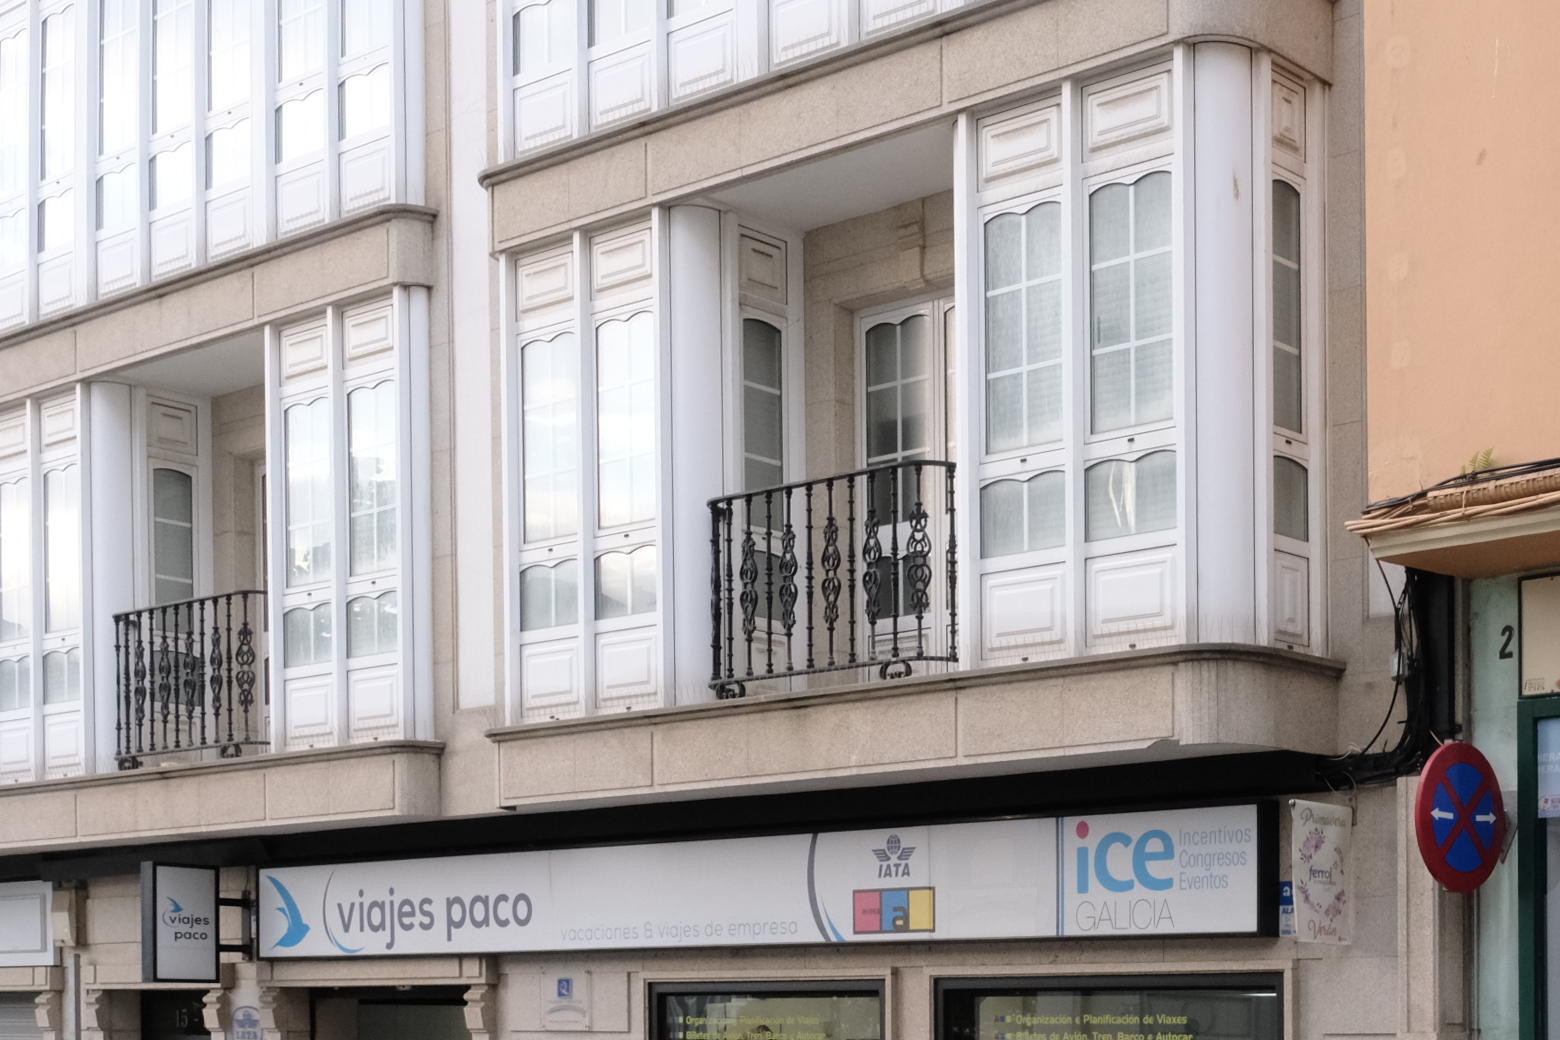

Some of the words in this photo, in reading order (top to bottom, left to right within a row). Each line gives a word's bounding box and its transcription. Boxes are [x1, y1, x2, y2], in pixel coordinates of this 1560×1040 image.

[1499, 624, 1514, 660] 2
[1178, 825, 1252, 847] Incentivos
[1076, 820, 1176, 895] ice
[1178, 848, 1248, 872] Congresos
[877, 862, 911, 879] IATA
[1178, 871, 1229, 891] Eventos
[169, 913, 210, 929] viajes
[336, 886, 435, 950] viajes
[446, 892, 533, 942] paco
[1075, 898, 1175, 932] GALICIA
[174, 931, 208, 942] paco
[560, 923, 640, 942] vacaciones
[657, 920, 700, 943] viajes
[704, 920, 723, 938] de
[727, 919, 798, 938] empresa
[1083, 1014, 1140, 1025] Planificación
[1142, 1014, 1154, 1024] de
[1156, 1014, 1188, 1025] Viaxes
[1049, 1031, 1060, 1040] de
